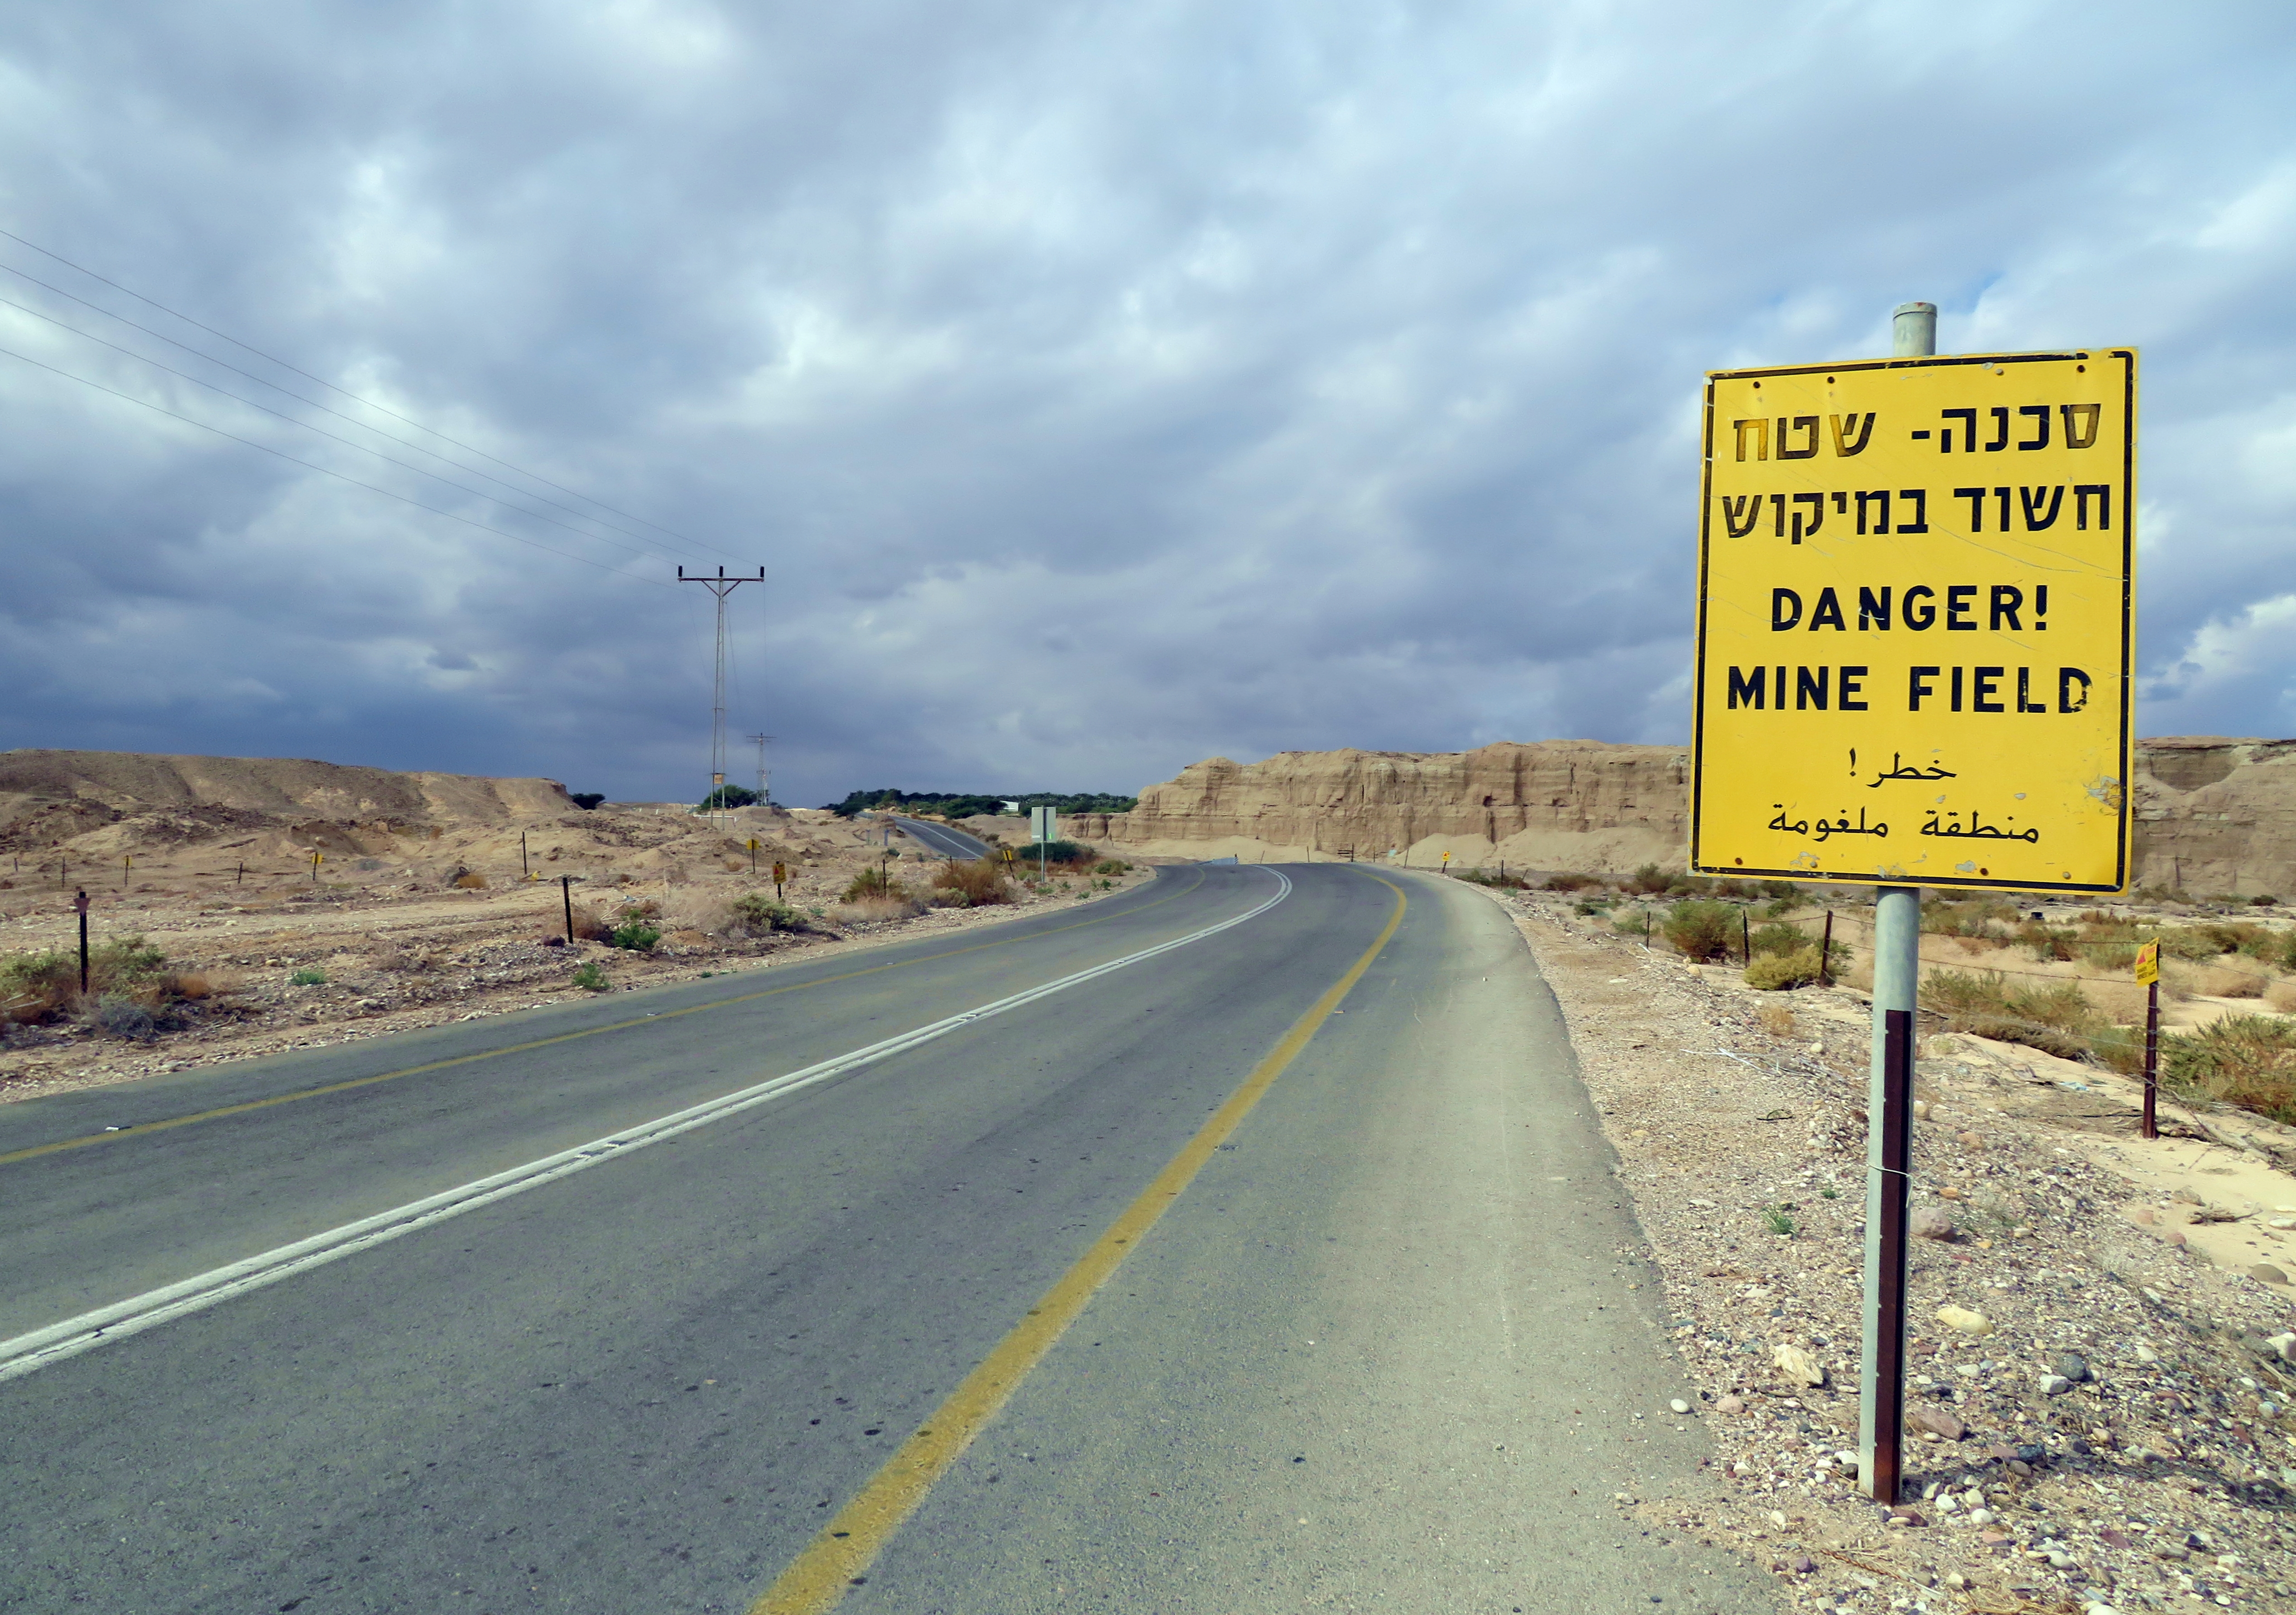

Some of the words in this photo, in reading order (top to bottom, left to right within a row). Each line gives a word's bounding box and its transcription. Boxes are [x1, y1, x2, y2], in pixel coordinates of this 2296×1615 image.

[1734, 413, 1876, 462] שטח
[1722, 489, 1928, 544] במיקוש
[1954, 485, 2110, 532] חשוד
[1772, 585, 2047, 631] DANGER!
[1728, 666, 1868, 711] MINE
[1909, 666, 2092, 713] FIELD
[1768, 804, 1888, 842] ملغومة
[1920, 810, 2038, 843] منطقة
